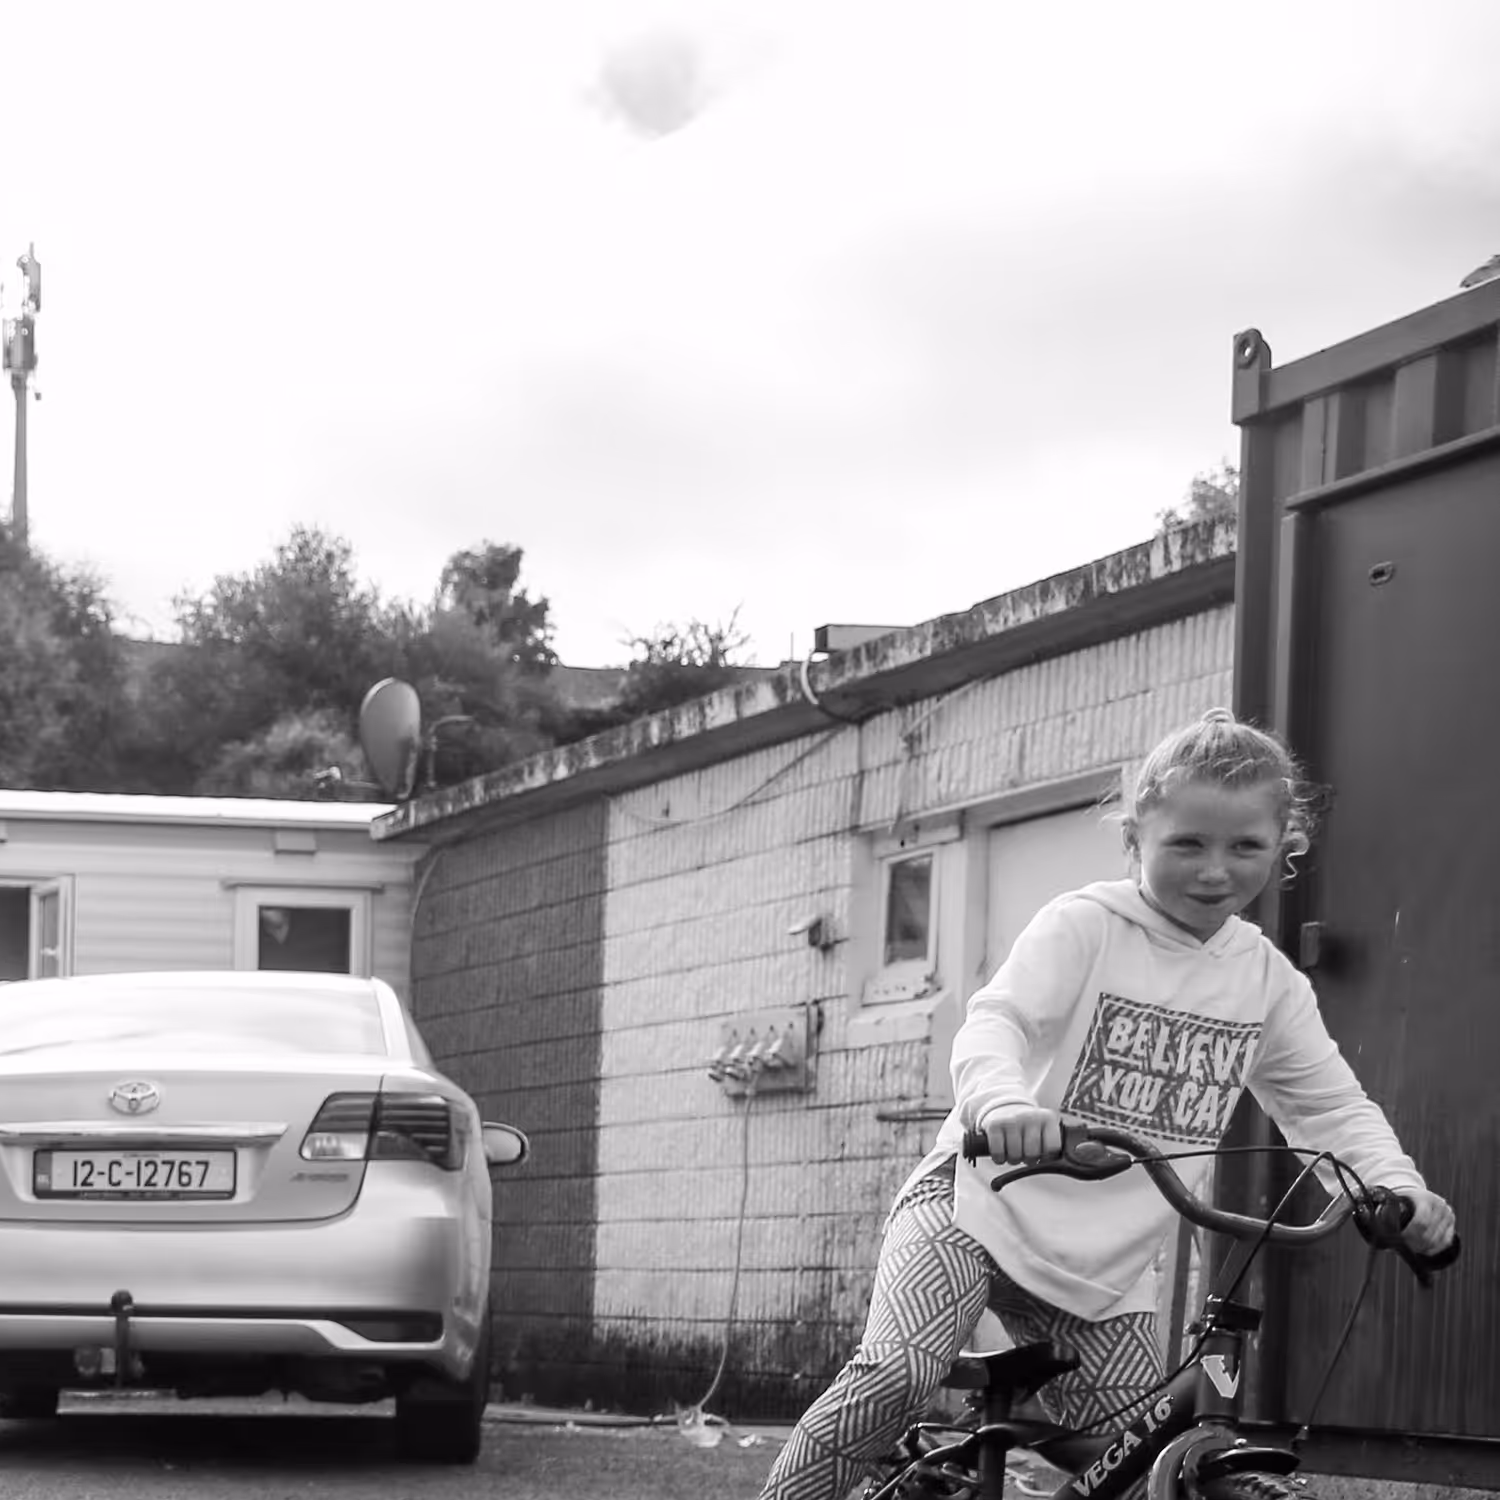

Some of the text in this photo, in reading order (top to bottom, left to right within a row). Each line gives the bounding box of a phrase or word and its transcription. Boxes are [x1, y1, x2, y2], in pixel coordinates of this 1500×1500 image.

[1102, 1065, 1164, 1113] YOU
[73, 1160, 210, 1187] 12-C-12767
[1073, 1393, 1173, 1497] VEGA 16
